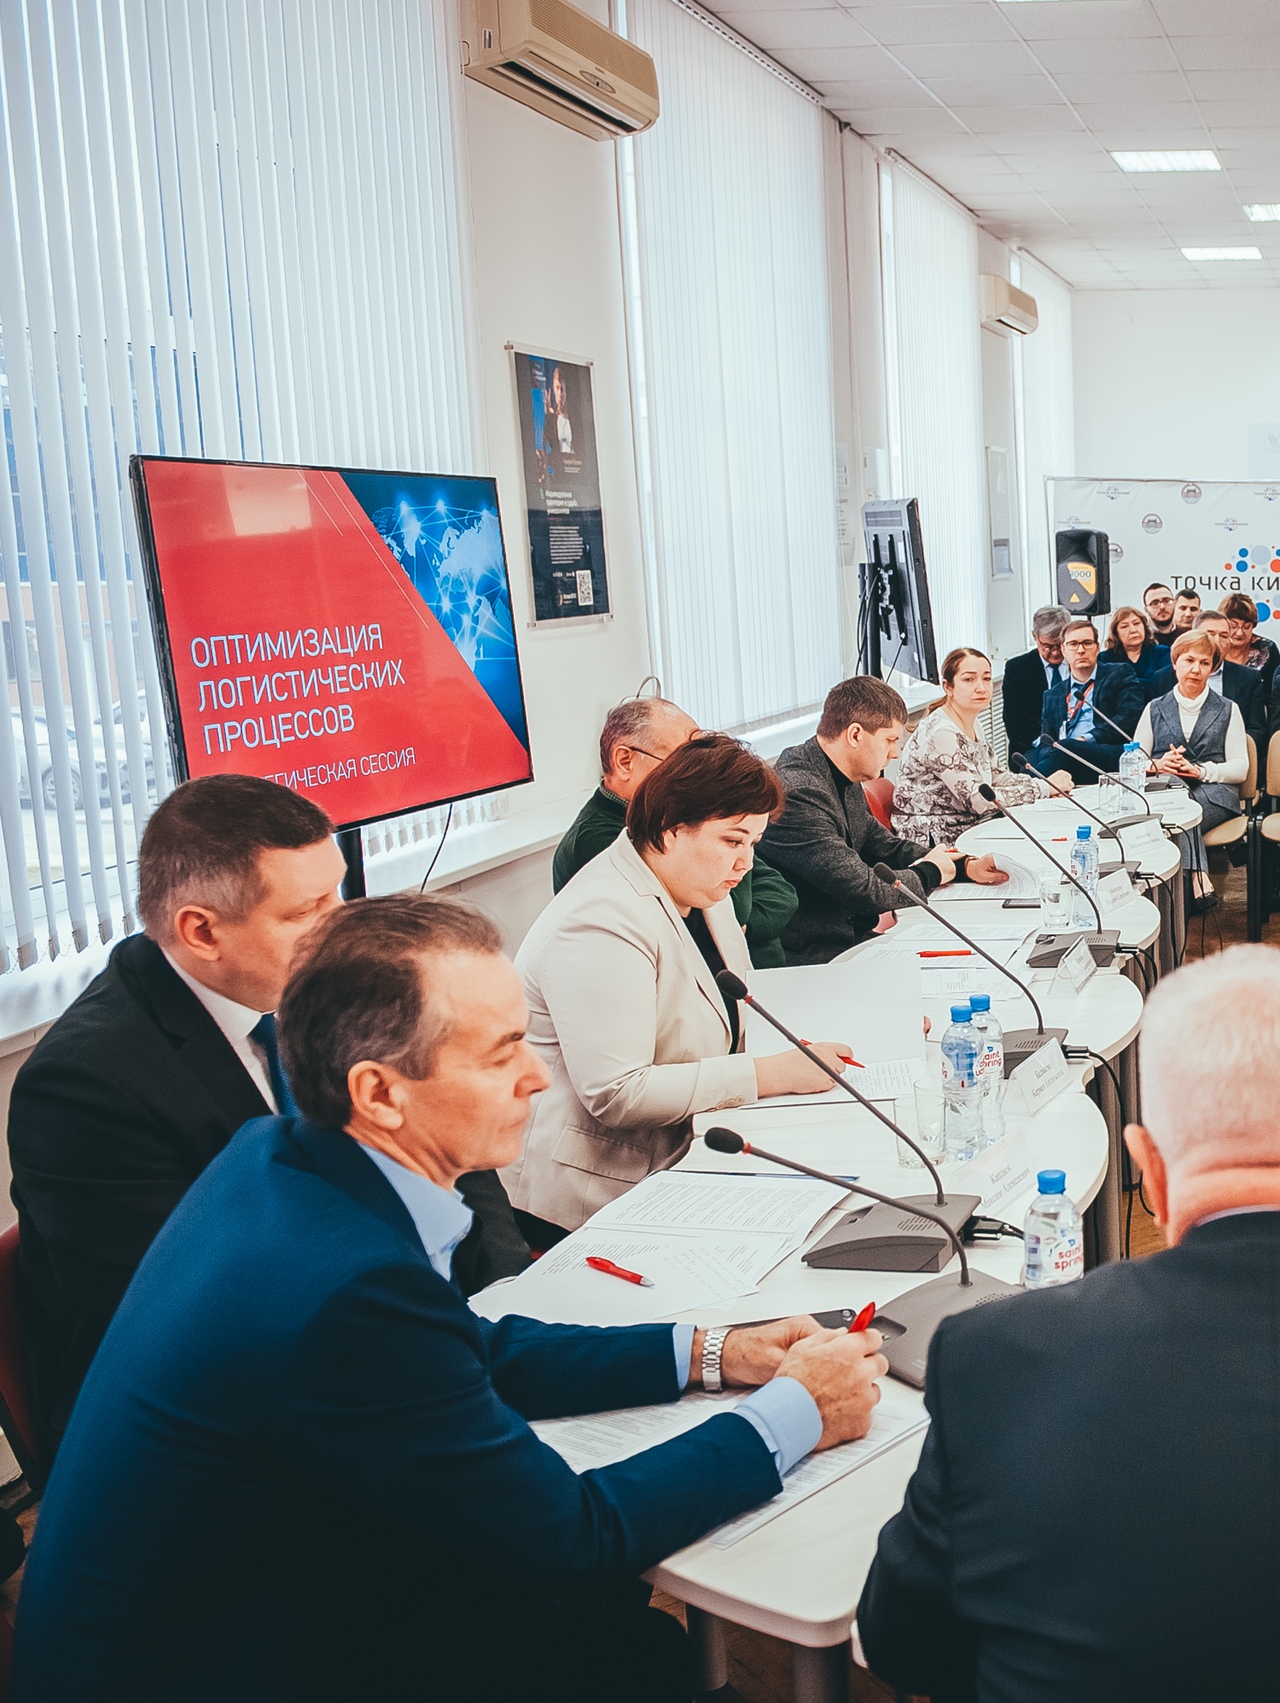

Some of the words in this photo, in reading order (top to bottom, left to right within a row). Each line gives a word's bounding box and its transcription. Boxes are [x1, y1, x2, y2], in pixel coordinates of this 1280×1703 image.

[1170, 575, 1242, 591] точка
[190, 622, 383, 668] ОПТИМИЗАЦИЯ
[198, 658, 406, 713] ЛОГИСТИЧЕСКИХ
[203, 704, 356, 755] ПРОЦЕССОВ
[262, 759, 358, 790] ГИЧЕСКАЯ
[360, 747, 416, 776] СЕССИЯ
[1058, 1244, 1081, 1259] sain
